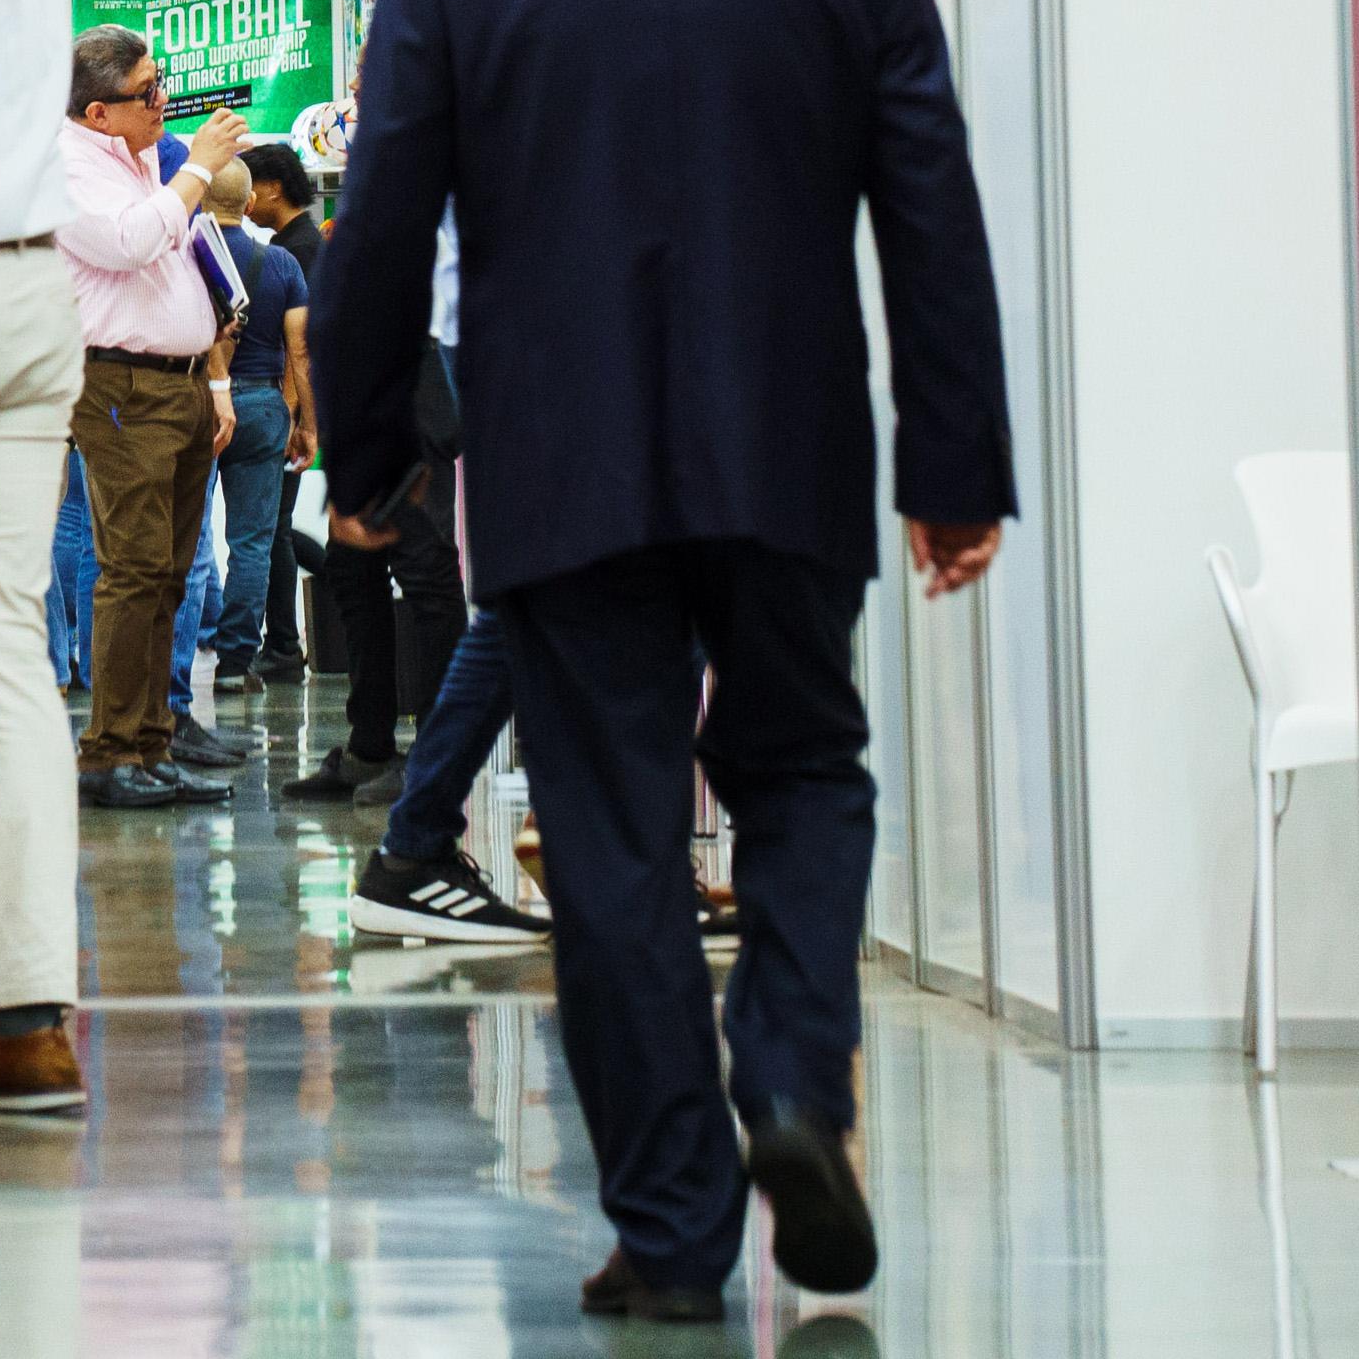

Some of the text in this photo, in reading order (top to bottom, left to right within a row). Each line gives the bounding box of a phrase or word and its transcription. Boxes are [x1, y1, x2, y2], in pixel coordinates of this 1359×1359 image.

[170, 50, 204, 74] GOOD
[188, 66, 225, 92] MAKE
[230, 64, 238, 84] A
[281, 49, 312, 74] BALL
